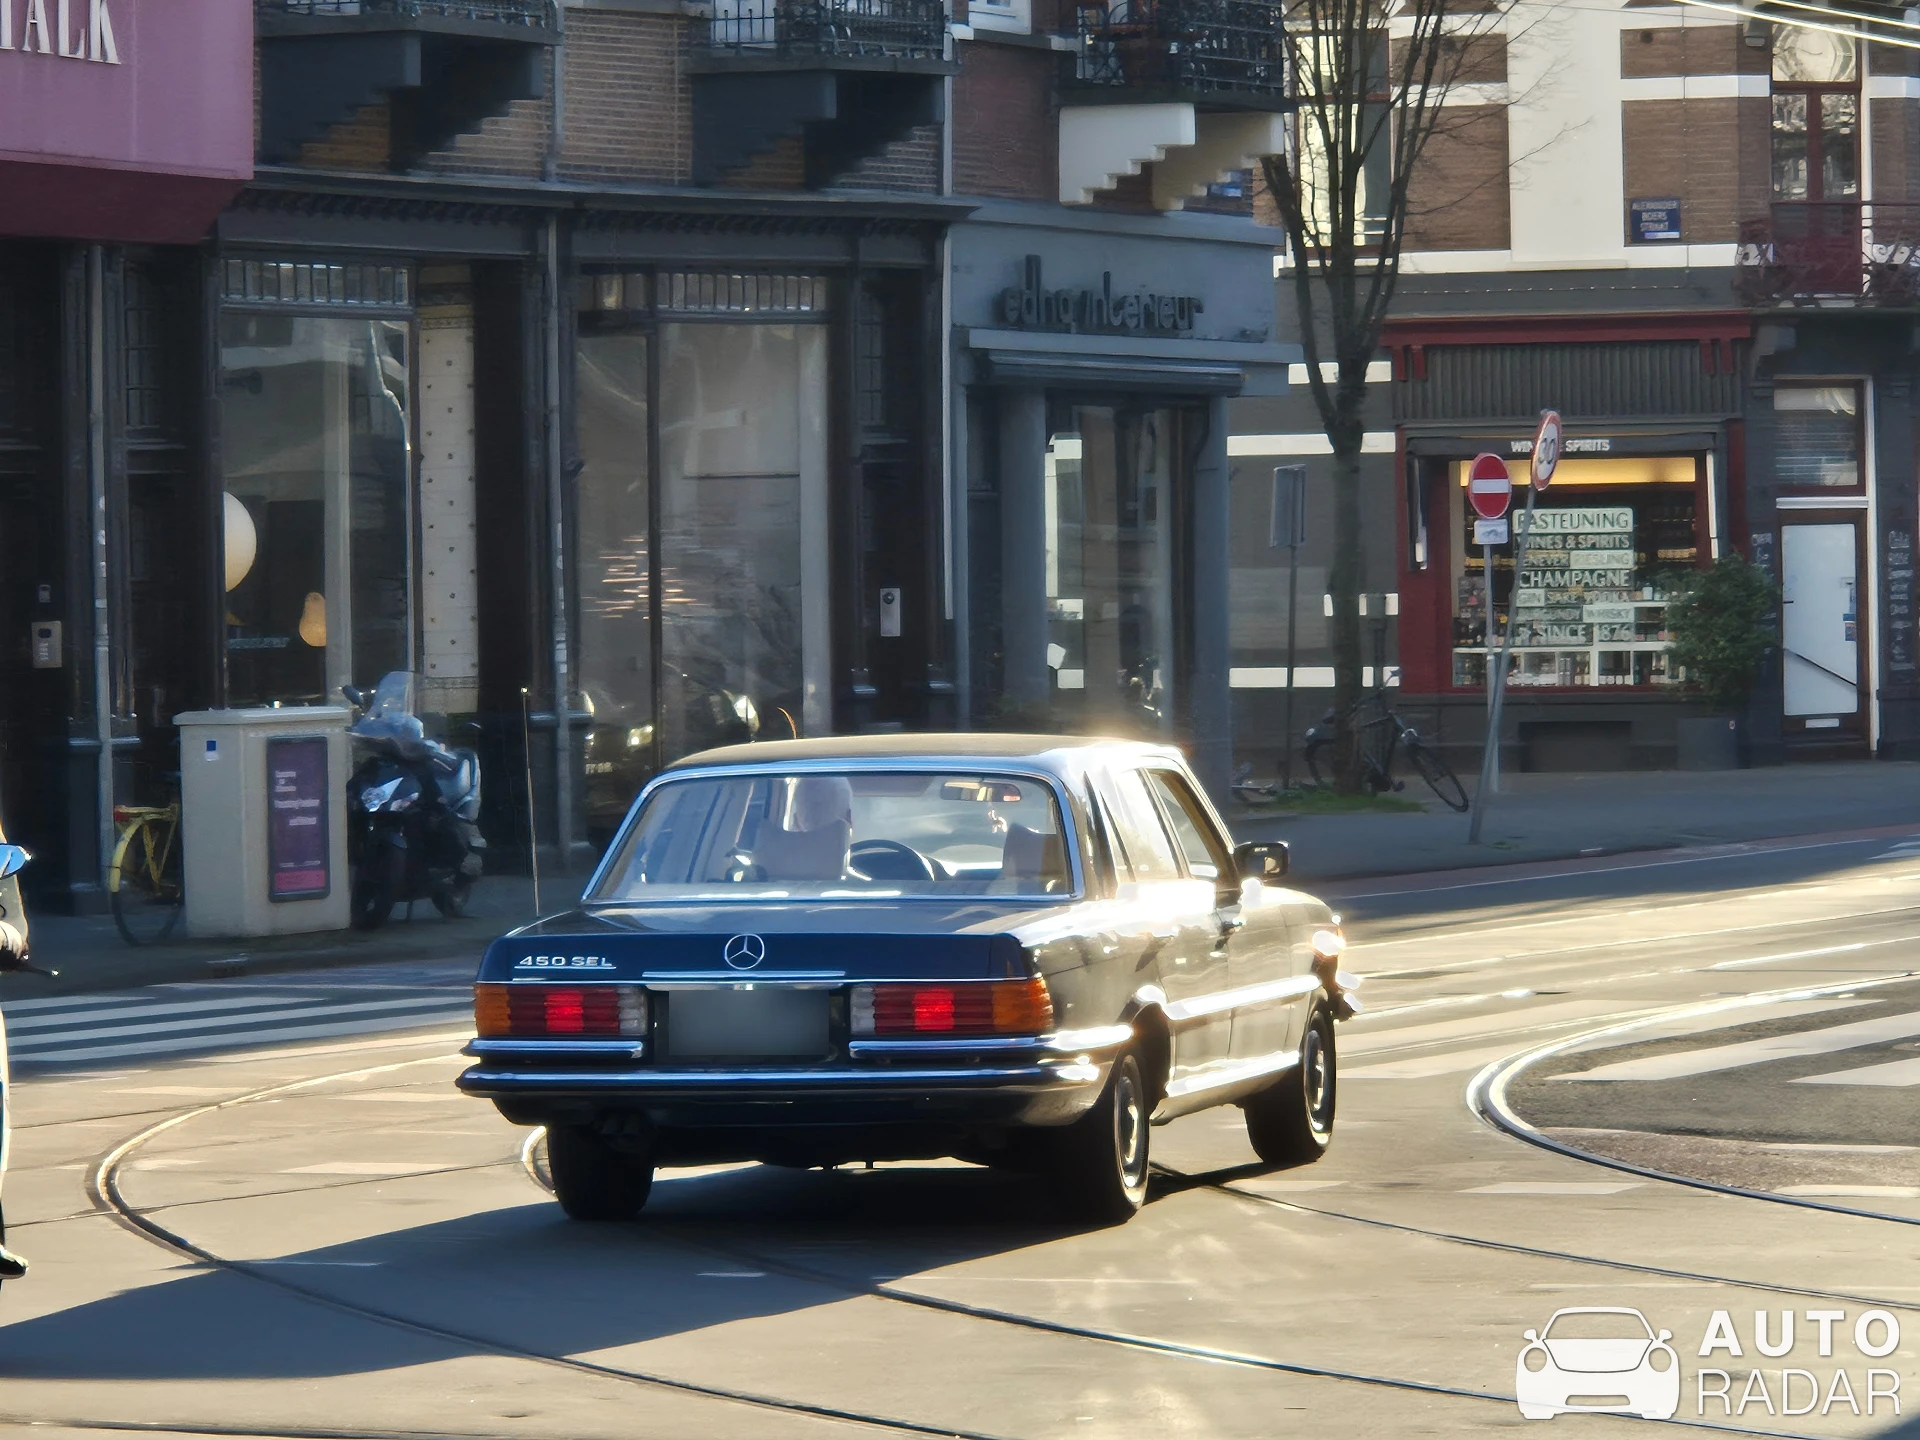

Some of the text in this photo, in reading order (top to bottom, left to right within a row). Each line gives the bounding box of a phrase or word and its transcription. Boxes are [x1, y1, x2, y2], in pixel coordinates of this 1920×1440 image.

[1511, 439, 1610, 452] WIN SPIRITS
[1566, 535, 1576, 549] &
[1578, 534, 1630, 549] SPIRITS
[1522, 553, 1569, 566] ENEVER
[1520, 570, 1630, 587] CHAMPAGNE
[1538, 624, 1632, 641] SINCE 876
[519, 955, 613, 967] 450 SEL
